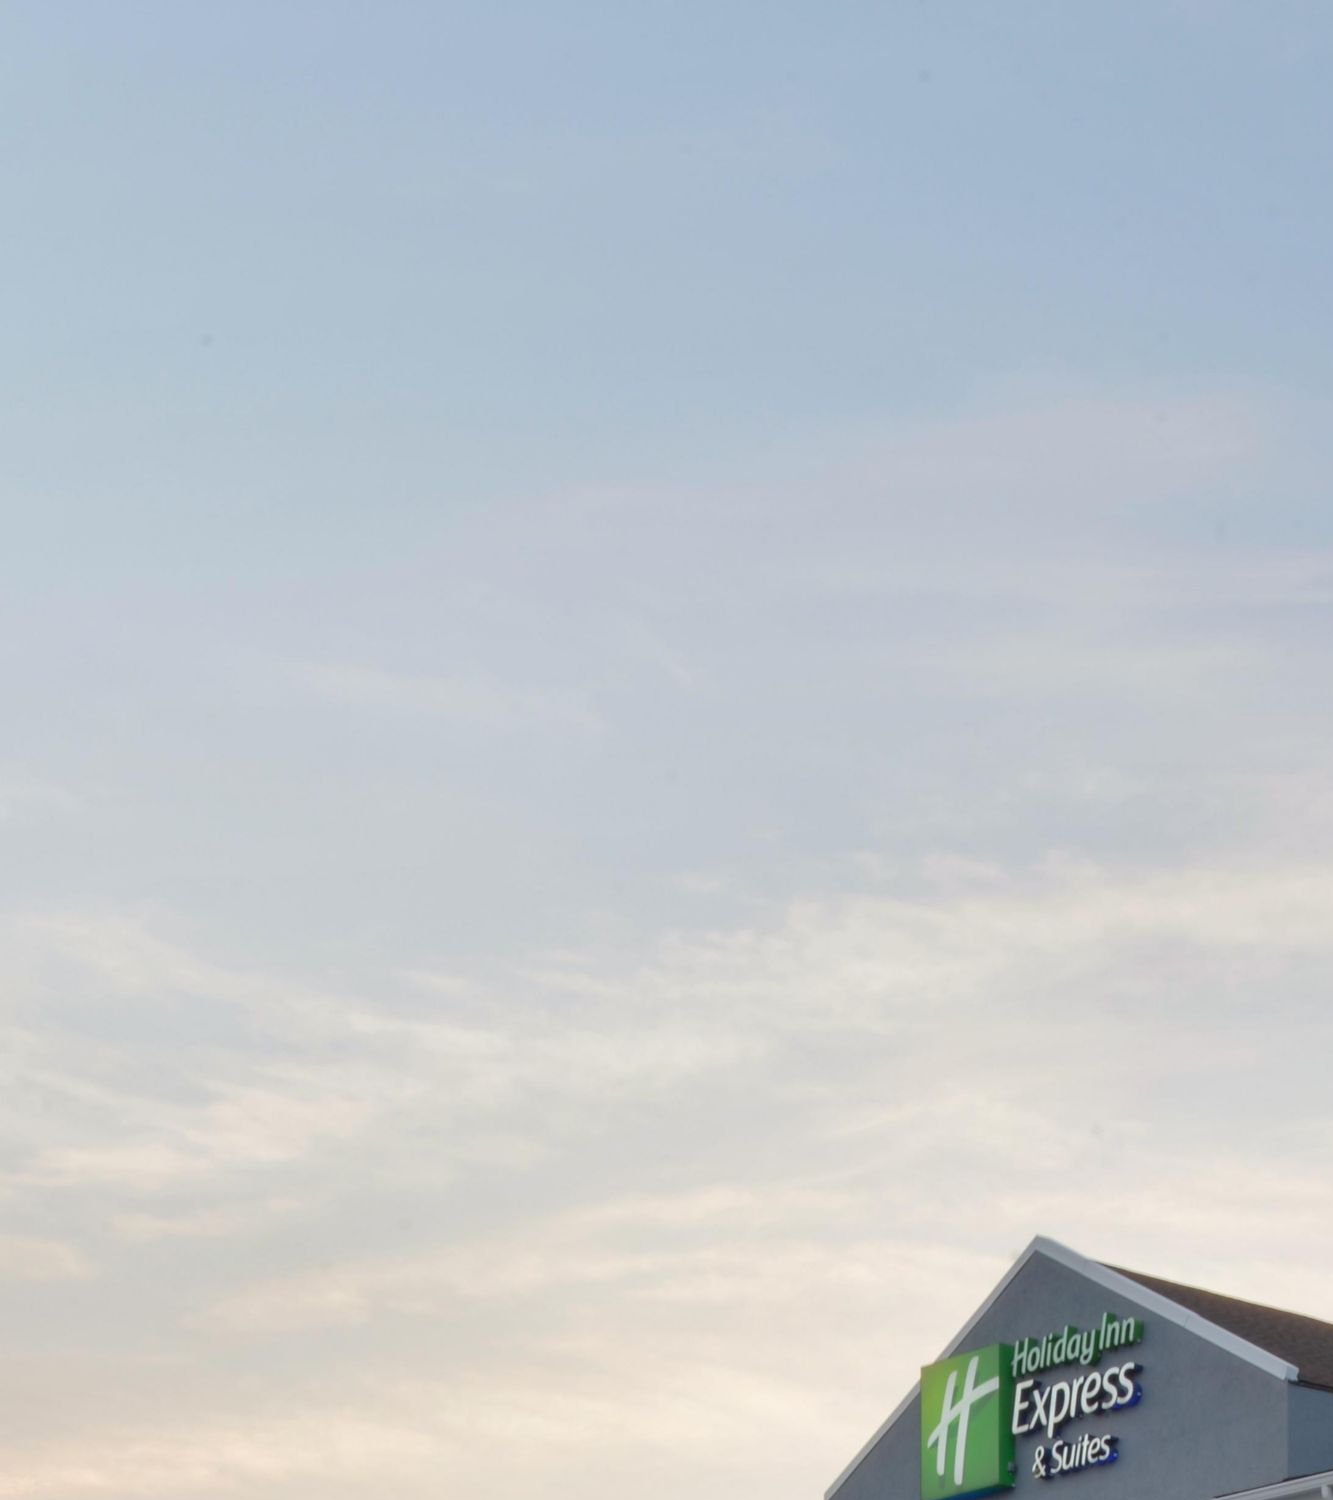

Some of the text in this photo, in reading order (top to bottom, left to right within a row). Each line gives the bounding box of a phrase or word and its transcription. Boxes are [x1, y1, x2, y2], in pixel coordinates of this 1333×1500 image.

[1011, 1312, 1136, 1377] Holiday Inn
[1011, 1361, 1136, 1438] Express
[1032, 1433, 1112, 1478] & Suites
